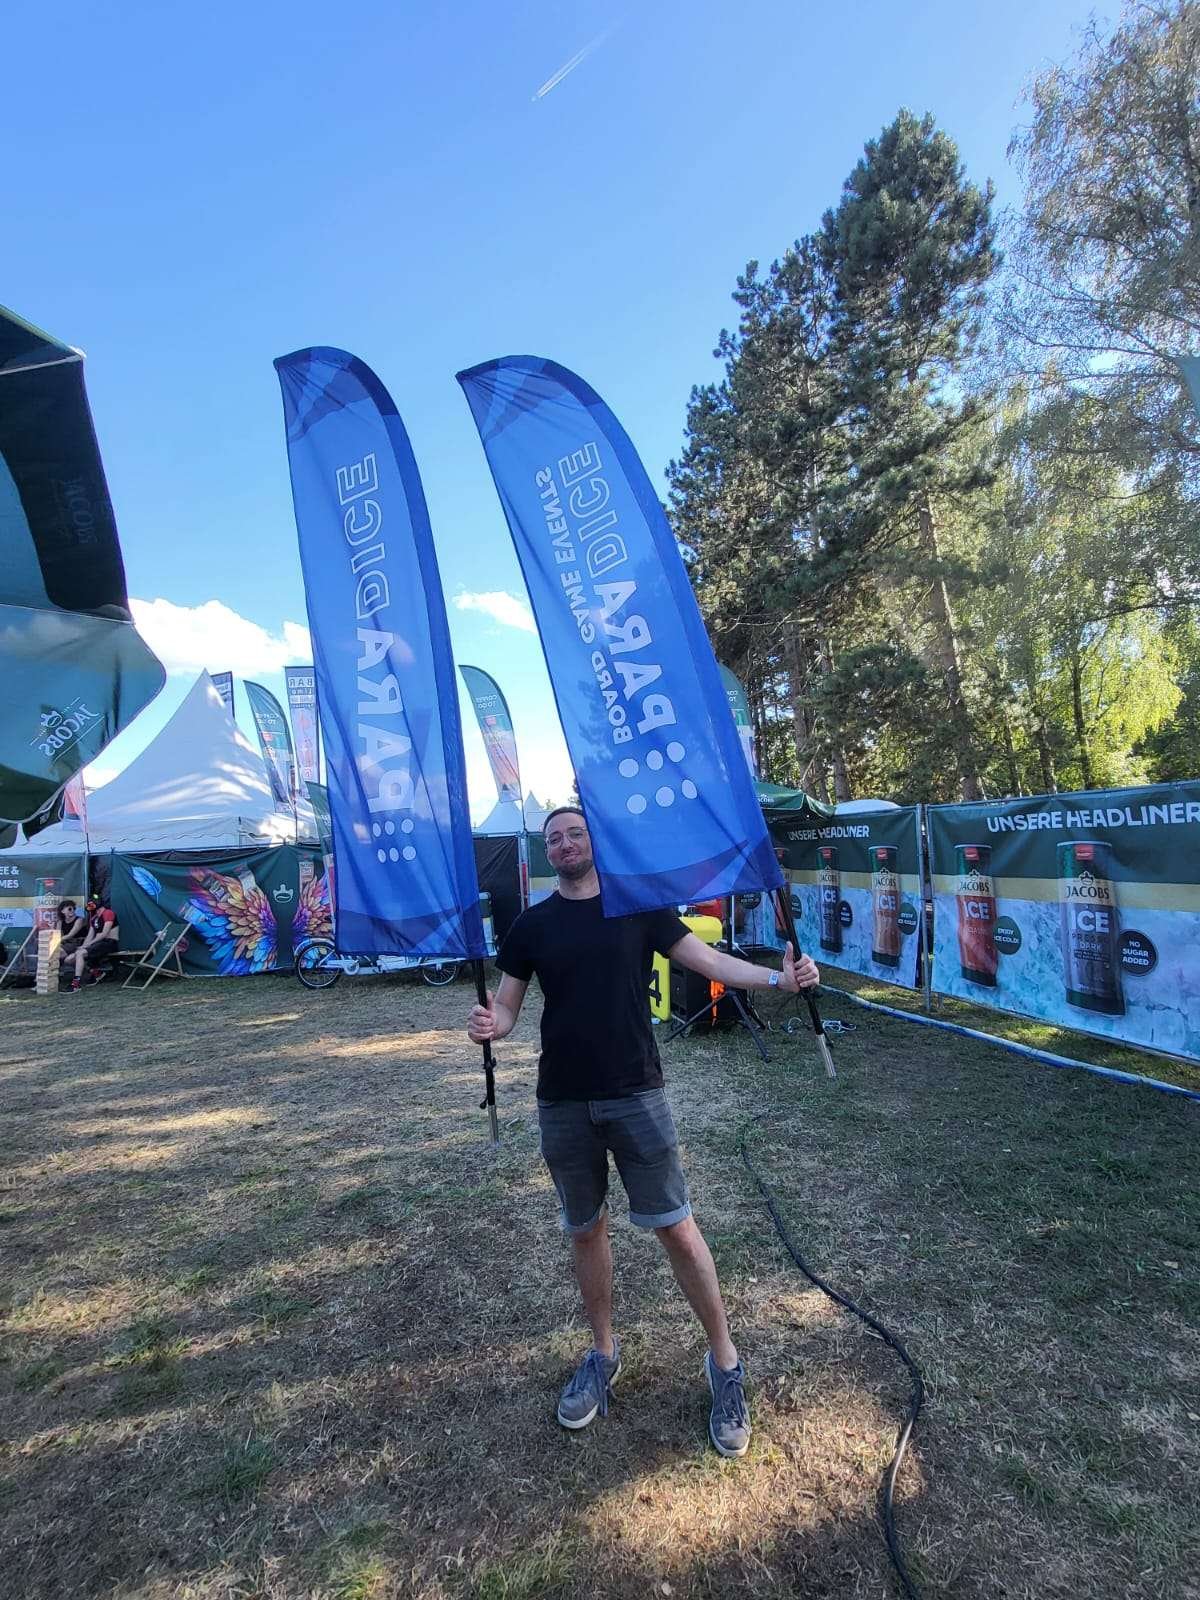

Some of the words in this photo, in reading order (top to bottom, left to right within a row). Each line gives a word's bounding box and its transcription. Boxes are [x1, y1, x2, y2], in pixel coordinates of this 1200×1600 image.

[986, 811, 1064, 833] UNSERE
[1066, 802, 1200, 828] HEADLINER
[788, 829, 818, 841] UNSERE
[818, 825, 870, 839] HEADLINER
[960, 880, 990, 893] JACOBS
[1065, 886, 1110, 900] JACOBS
[963, 901, 990, 920] ICE
[1069, 909, 1110, 933] ICE
[1128, 940, 1141, 949] NO
[1122, 948, 1149, 958] SUGAR
[1122, 956, 1149, 966] ADDED
